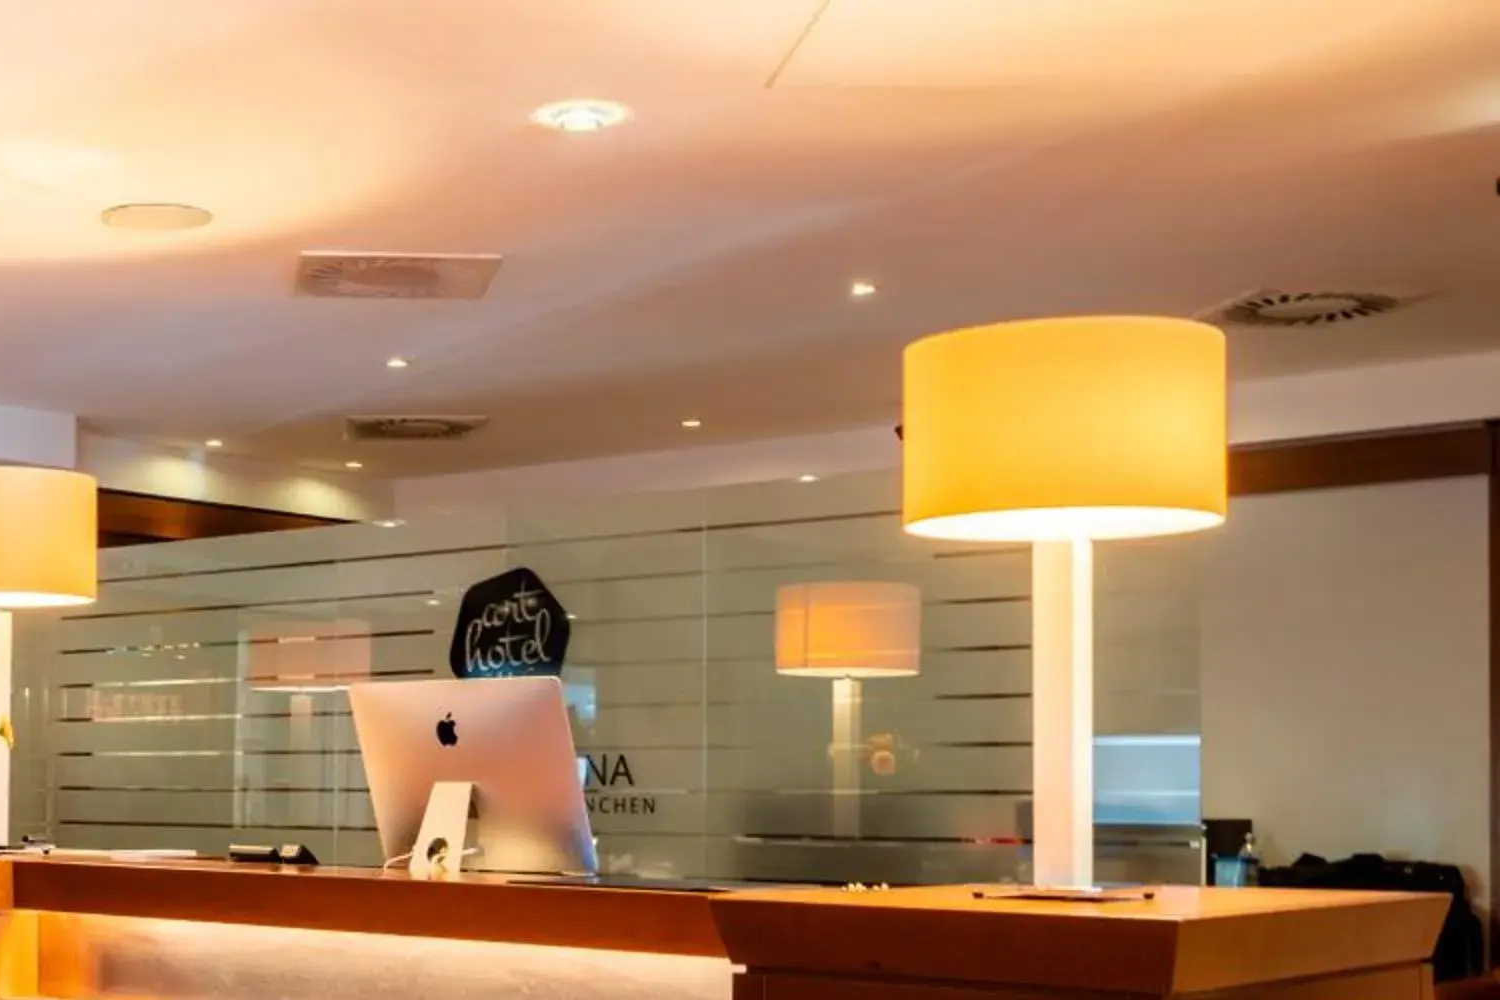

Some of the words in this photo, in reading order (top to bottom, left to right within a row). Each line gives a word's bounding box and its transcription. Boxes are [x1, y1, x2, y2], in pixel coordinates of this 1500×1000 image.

[482, 577, 544, 627] art
[465, 608, 550, 672] hotel
[584, 753, 635, 787] NA
[584, 796, 656, 815] NCHEN
